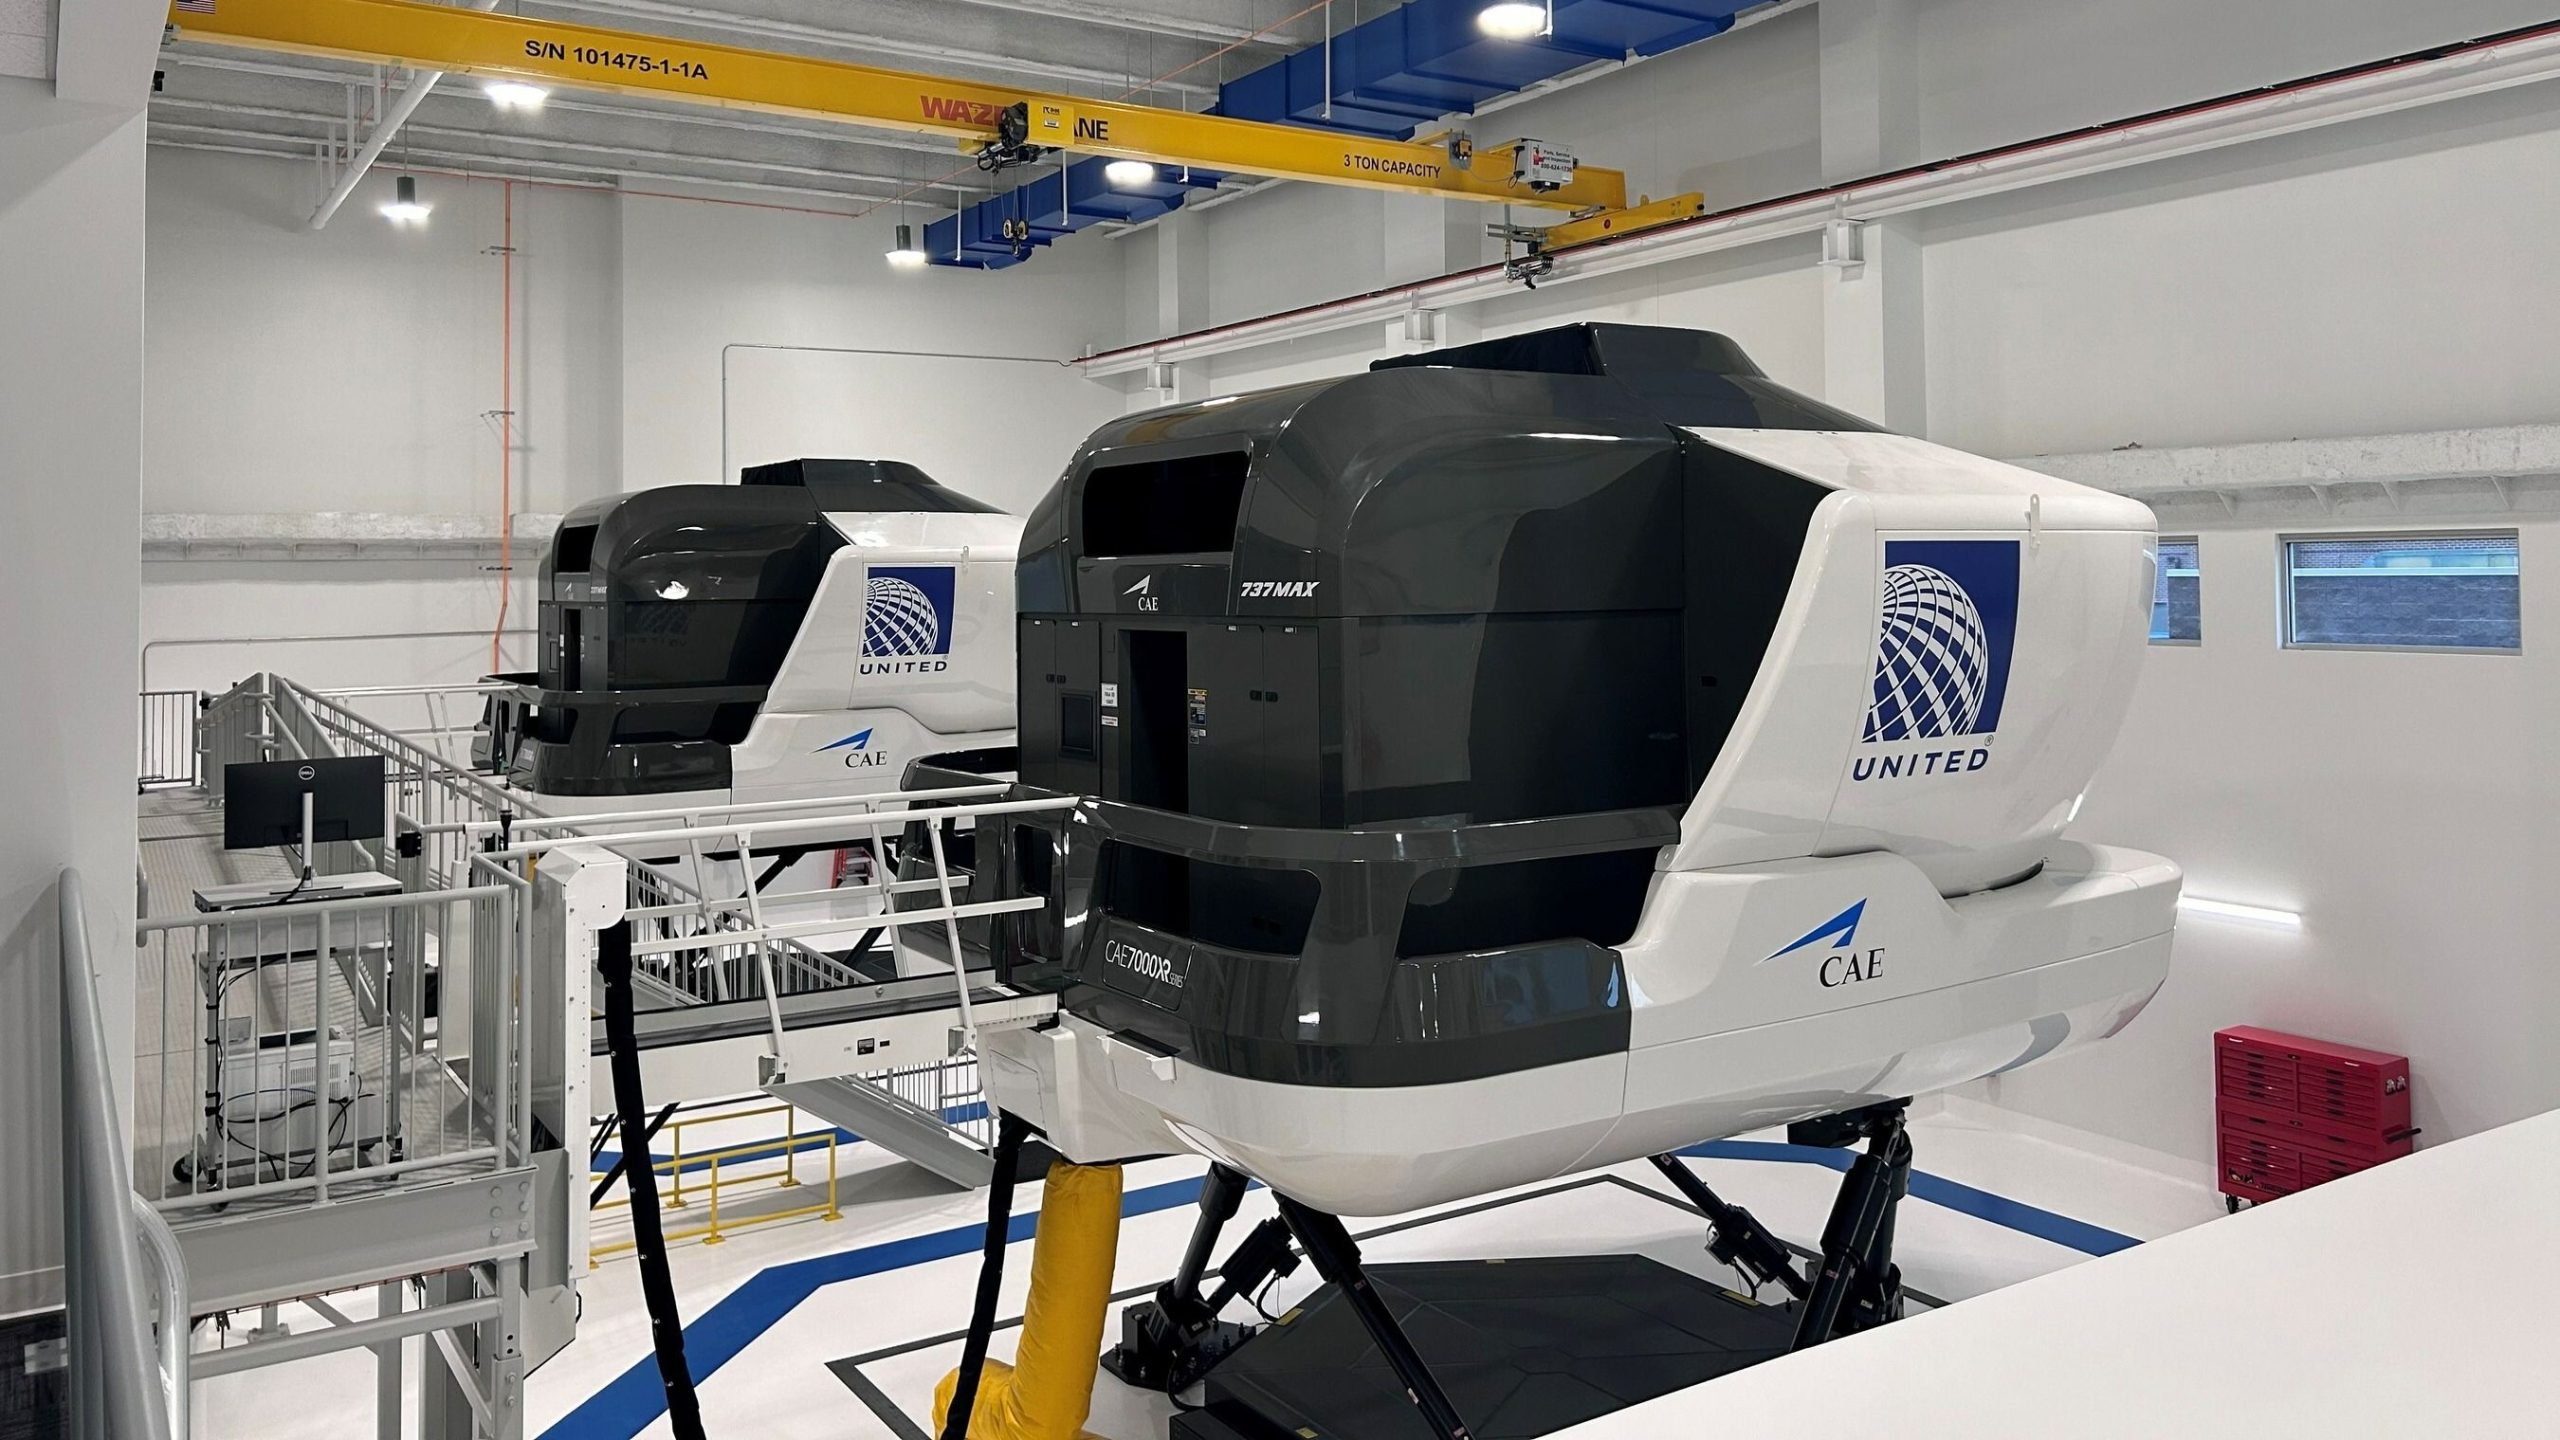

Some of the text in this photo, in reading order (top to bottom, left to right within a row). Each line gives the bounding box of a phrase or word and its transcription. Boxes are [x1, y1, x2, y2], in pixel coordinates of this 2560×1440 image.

[525, 40, 709, 80] S/N 101475-1-1A
[1073, 117, 1109, 141] NE
[1344, 154, 1441, 179] 3 TON CAPACITY
[1241, 581, 1321, 598] 737MAX
[1138, 597, 1159, 612] CAE
[860, 661, 947, 675] UNITED
[845, 751, 887, 768] CAE
[1852, 749, 1989, 781] UNITED
[1819, 948, 1885, 987] CAE
